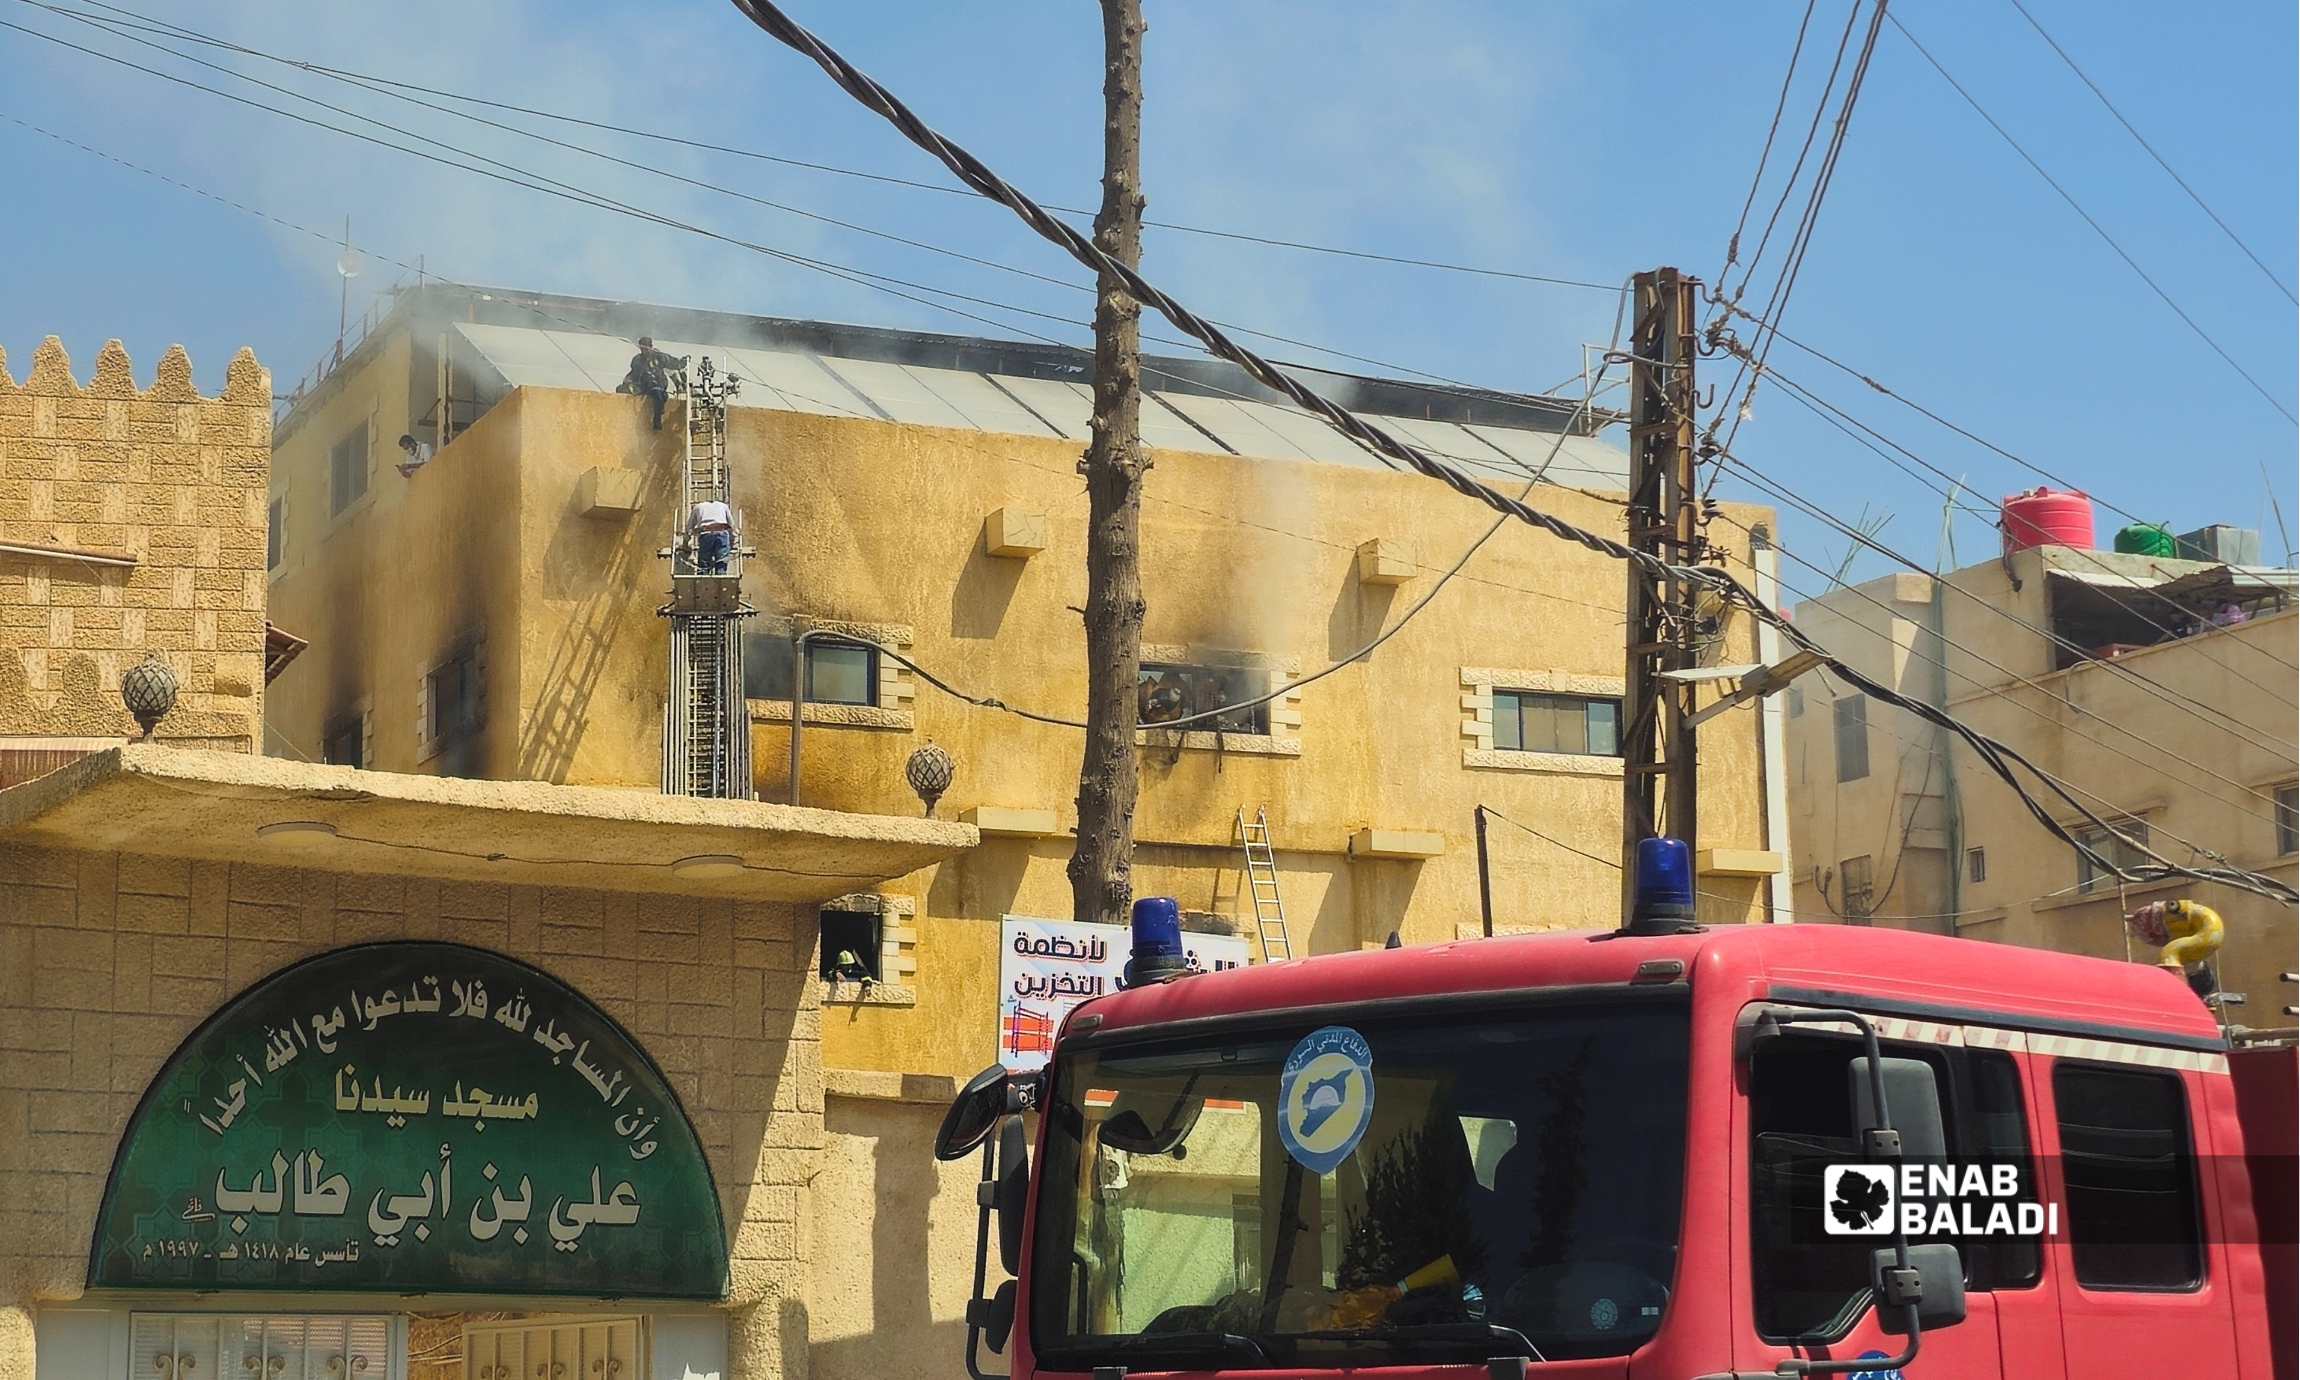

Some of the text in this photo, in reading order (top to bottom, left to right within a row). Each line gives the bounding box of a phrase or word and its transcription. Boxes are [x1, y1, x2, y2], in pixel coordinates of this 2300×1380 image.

[1013, 931, 1107, 962] لأنظمة
[351, 975, 441, 1031] تدعوا
[449, 979, 488, 1019] فلا
[1013, 972, 1105, 1000] التخزين
[312, 1006, 345, 1054] مع
[494, 988, 532, 1033] لله
[264, 1018, 308, 1073] الله
[533, 1018, 632, 1107] المساجد
[1288, 1031, 1368, 1072] الدفاع المدني السوري
[335, 1063, 539, 1133] مسجد سيدنا
[614, 1106, 660, 1160] وأن
[214, 1142, 642, 1253] علي بن أبي طالب
[143, 1243, 153, 1263] م
[159, 1240, 199, 1258] ١٩٩٧
[244, 1241, 279, 1260] ١٤١٨
[284, 1241, 310, 1264] عام
[314, 1237, 360, 1267] تأسس
